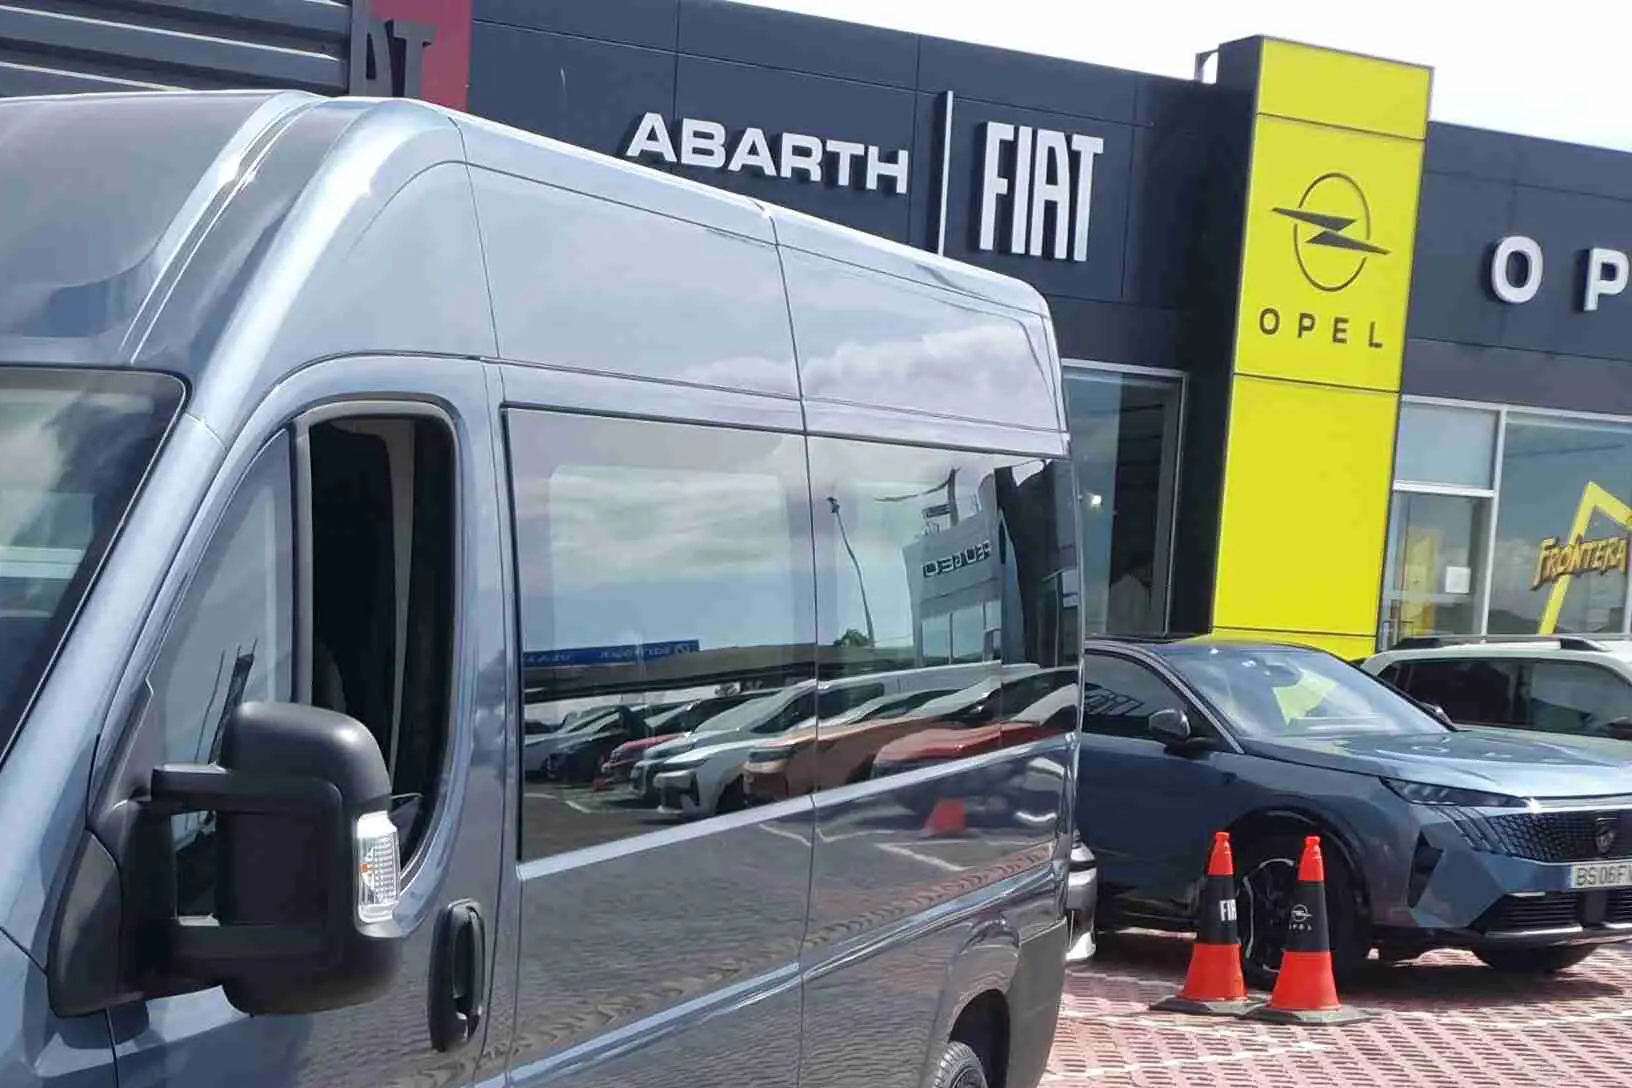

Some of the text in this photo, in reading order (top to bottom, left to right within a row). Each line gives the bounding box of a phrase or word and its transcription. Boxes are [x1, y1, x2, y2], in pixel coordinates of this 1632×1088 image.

[624, 111, 909, 195] ABARTH
[979, 121, 1105, 262] FIAT
[1259, 307, 1383, 349] OPEL
